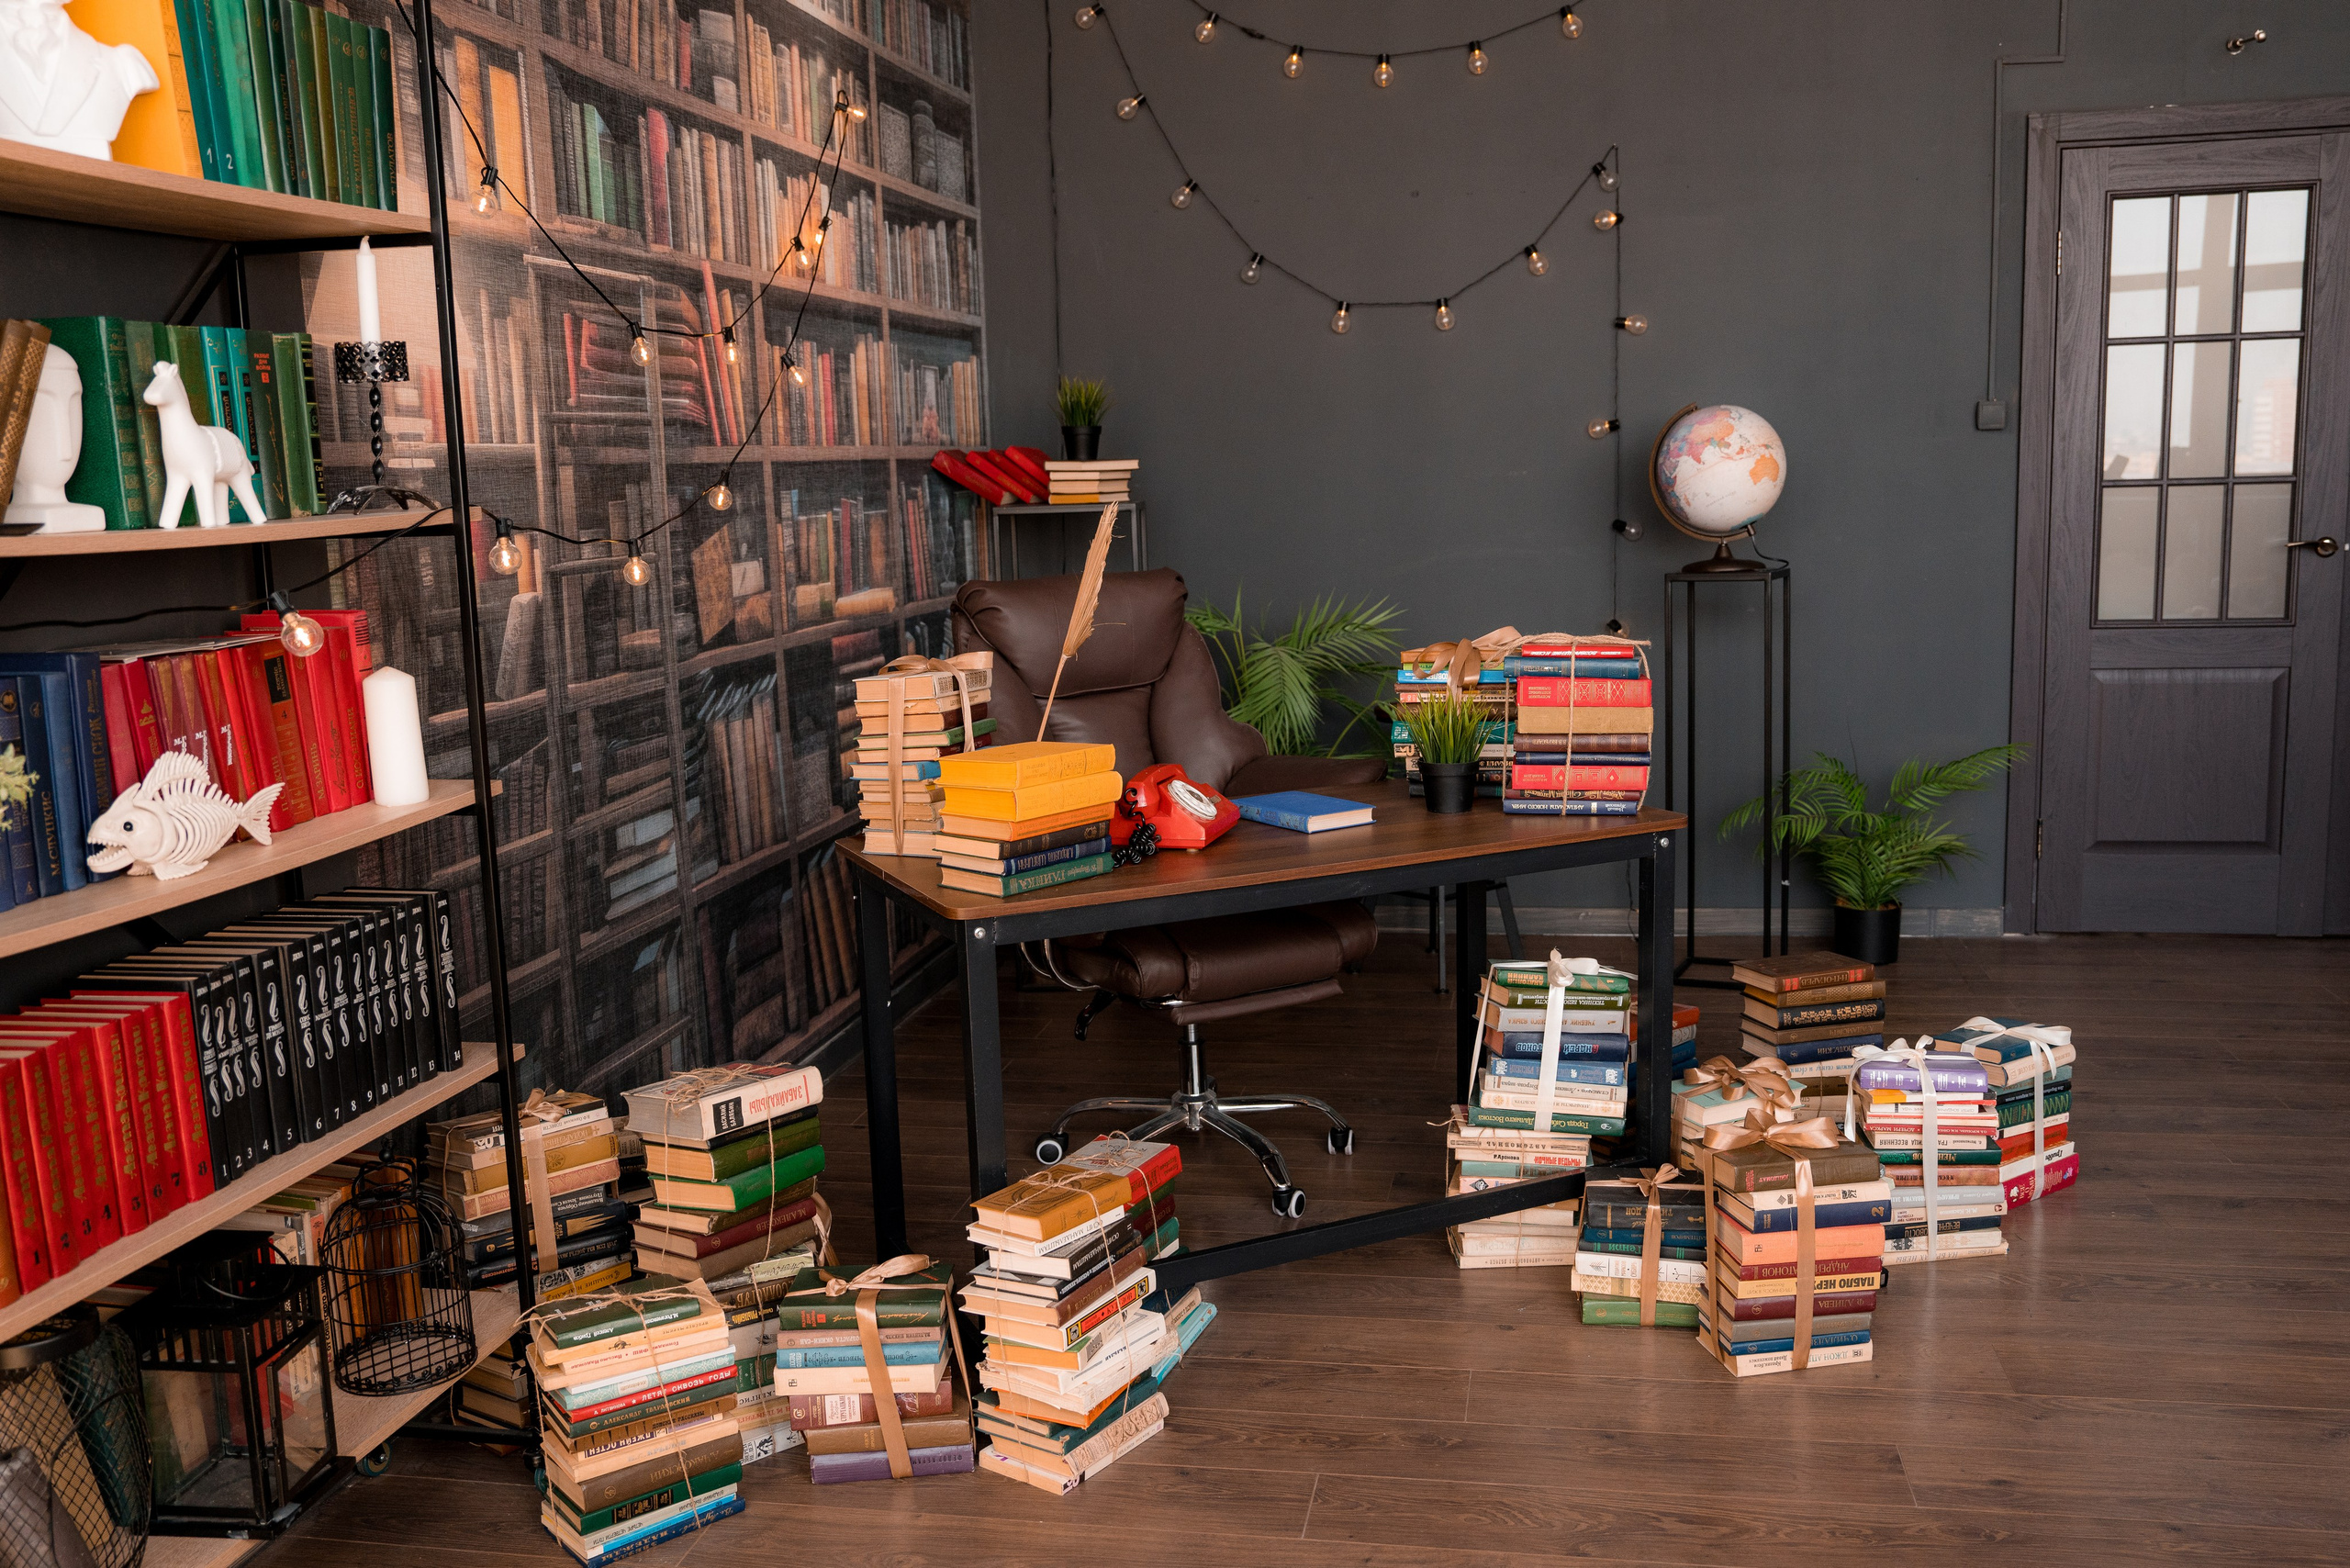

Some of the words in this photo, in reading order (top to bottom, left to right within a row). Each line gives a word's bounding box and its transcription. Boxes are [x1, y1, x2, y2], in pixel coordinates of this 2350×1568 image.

[207, 148, 212, 163] 1
[226, 154, 233, 170] 2
[281, 710, 287, 720] 4
[1018, 870, 1066, 890] ГЛИНКА
[437, 899, 447, 908] ДЮМА
[411, 906, 422, 915] ДЮМА
[379, 917, 390, 927] ДЮМА
[364, 923, 375, 933] ДЮМА
[349, 929, 359, 939] ДЮМА
[331, 937, 341, 946] ДЮМА
[313, 943, 324, 953] ДЮМА
[292, 951, 304, 962] ДЮМА
[257, 958, 274, 971] ДЮМА
[238, 967, 251, 979] ДЮМА
[222, 973, 234, 985] ДЮМА
[210, 980, 222, 991] ДЮМА
[196, 986, 208, 997] ДЮМА
[453, 1050, 461, 1060] 14
[1562, 1044, 1600, 1055] АНДРЕЙ
[428, 1059, 435, 1070] 13
[410, 1067, 418, 1078] 12
[397, 1075, 404, 1086] 11
[381, 1081, 388, 1094] 10
[366, 1091, 373, 1102] 9
[749, 1085, 803, 1115] ЗАБАЙКАЛЬЦЫ
[351, 1100, 357, 1111] 8
[334, 1108, 341, 1119] 7
[720, 1103, 728, 1130] ВАСИЛИЙ
[1478, 1114, 1505, 1123] Востока
[316, 1117, 322, 1129] 6
[1567, 1120, 1589, 1128] Города
[286, 1128, 293, 1140] 5
[263, 1139, 269, 1151] 4
[1486, 1141, 1546, 1149] АВТОМОБИЛЬ
[247, 1148, 252, 1159] 3
[236, 1155, 242, 1168] 2
[197, 1160, 207, 1176] 8
[223, 1163, 227, 1176] 1
[171, 1171, 180, 1187] 7
[153, 1183, 162, 1198] 6
[131, 1196, 140, 1212] 5
[557, 1202, 578, 1212] Обручев
[577, 1198, 604, 1208] Владимир
[103, 1204, 112, 1220] 4
[1625, 1207, 1642, 1216] ДОН
[1870, 1205, 1885, 1217] 2
[83, 1218, 92, 1235] 3
[61, 1233, 70, 1250] 2
[1037, 1227, 1085, 1254] МАНДЕЛЬШТАМ
[1608, 1244, 1642, 1255] Генри
[34, 1249, 40, 1265] 1
[1072, 1243, 1105, 1271] МАНДЕЛЬШТАМ
[1896, 1255, 1918, 1263] НЕВЫ
[1815, 1261, 1850, 1275] АНДРЕЙ
[1839, 1276, 1875, 1288] ПАБЛО
[1818, 1298, 1853, 1309] АЛИЕВА
[651, 1340, 679, 1350] Геннадий
[632, 1348, 649, 1356] ФИШ
[1824, 1350, 1849, 1361] ДЖОН
[599, 1354, 622, 1363] Письмо
[642, 1389, 666, 1402] ЛЕТЯТ
[671, 1378, 704, 1392] СКВОЗЬ
[708, 1370, 732, 1383] ГОДЫ
[603, 1411, 643, 1426] АЛЕКСАНДР
[588, 1442, 617, 1456] ОСТЕН
[701, 1489, 724, 1503] ВЛАДИМИР
[627, 1522, 643, 1532] ЧЕТЫРЕ
[605, 1528, 627, 1540] ЧЕТВЕРТИ
